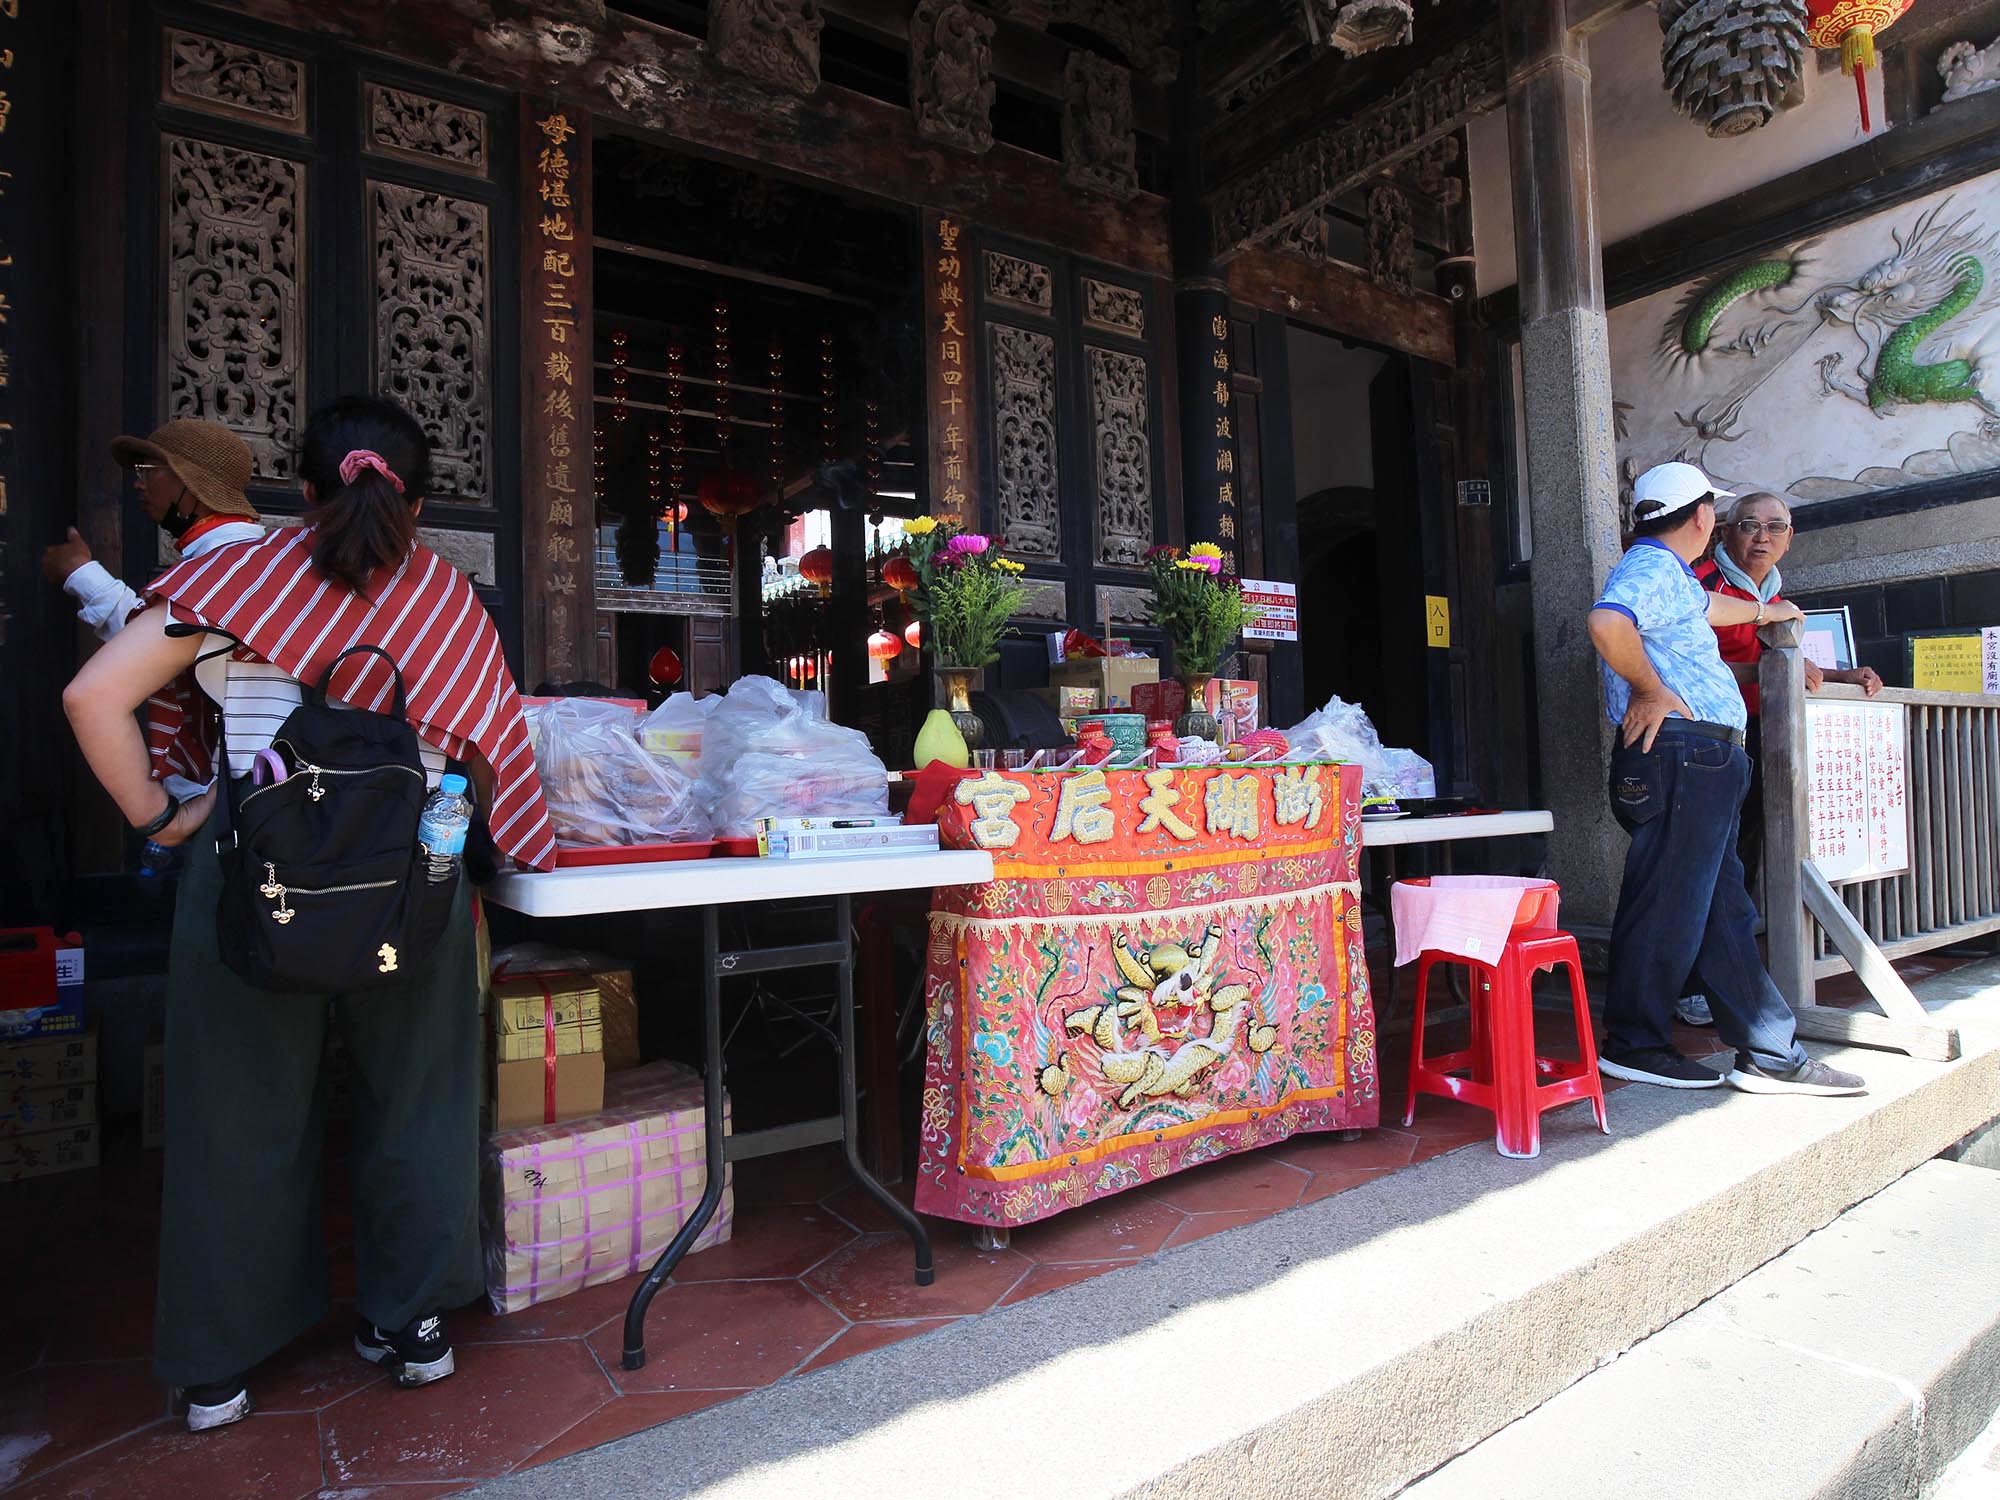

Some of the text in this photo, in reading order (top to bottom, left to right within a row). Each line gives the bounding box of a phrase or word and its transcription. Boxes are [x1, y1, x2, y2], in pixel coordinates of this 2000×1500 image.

[1432, 604, 1445, 637] 入口
[1986, 630, 1999, 690] 本宮沒有廁所
[954, 764, 1323, 849] 澎湖天后宮
[421, 1315, 438, 1330] NIKE
[424, 1331, 441, 1342] AIR
